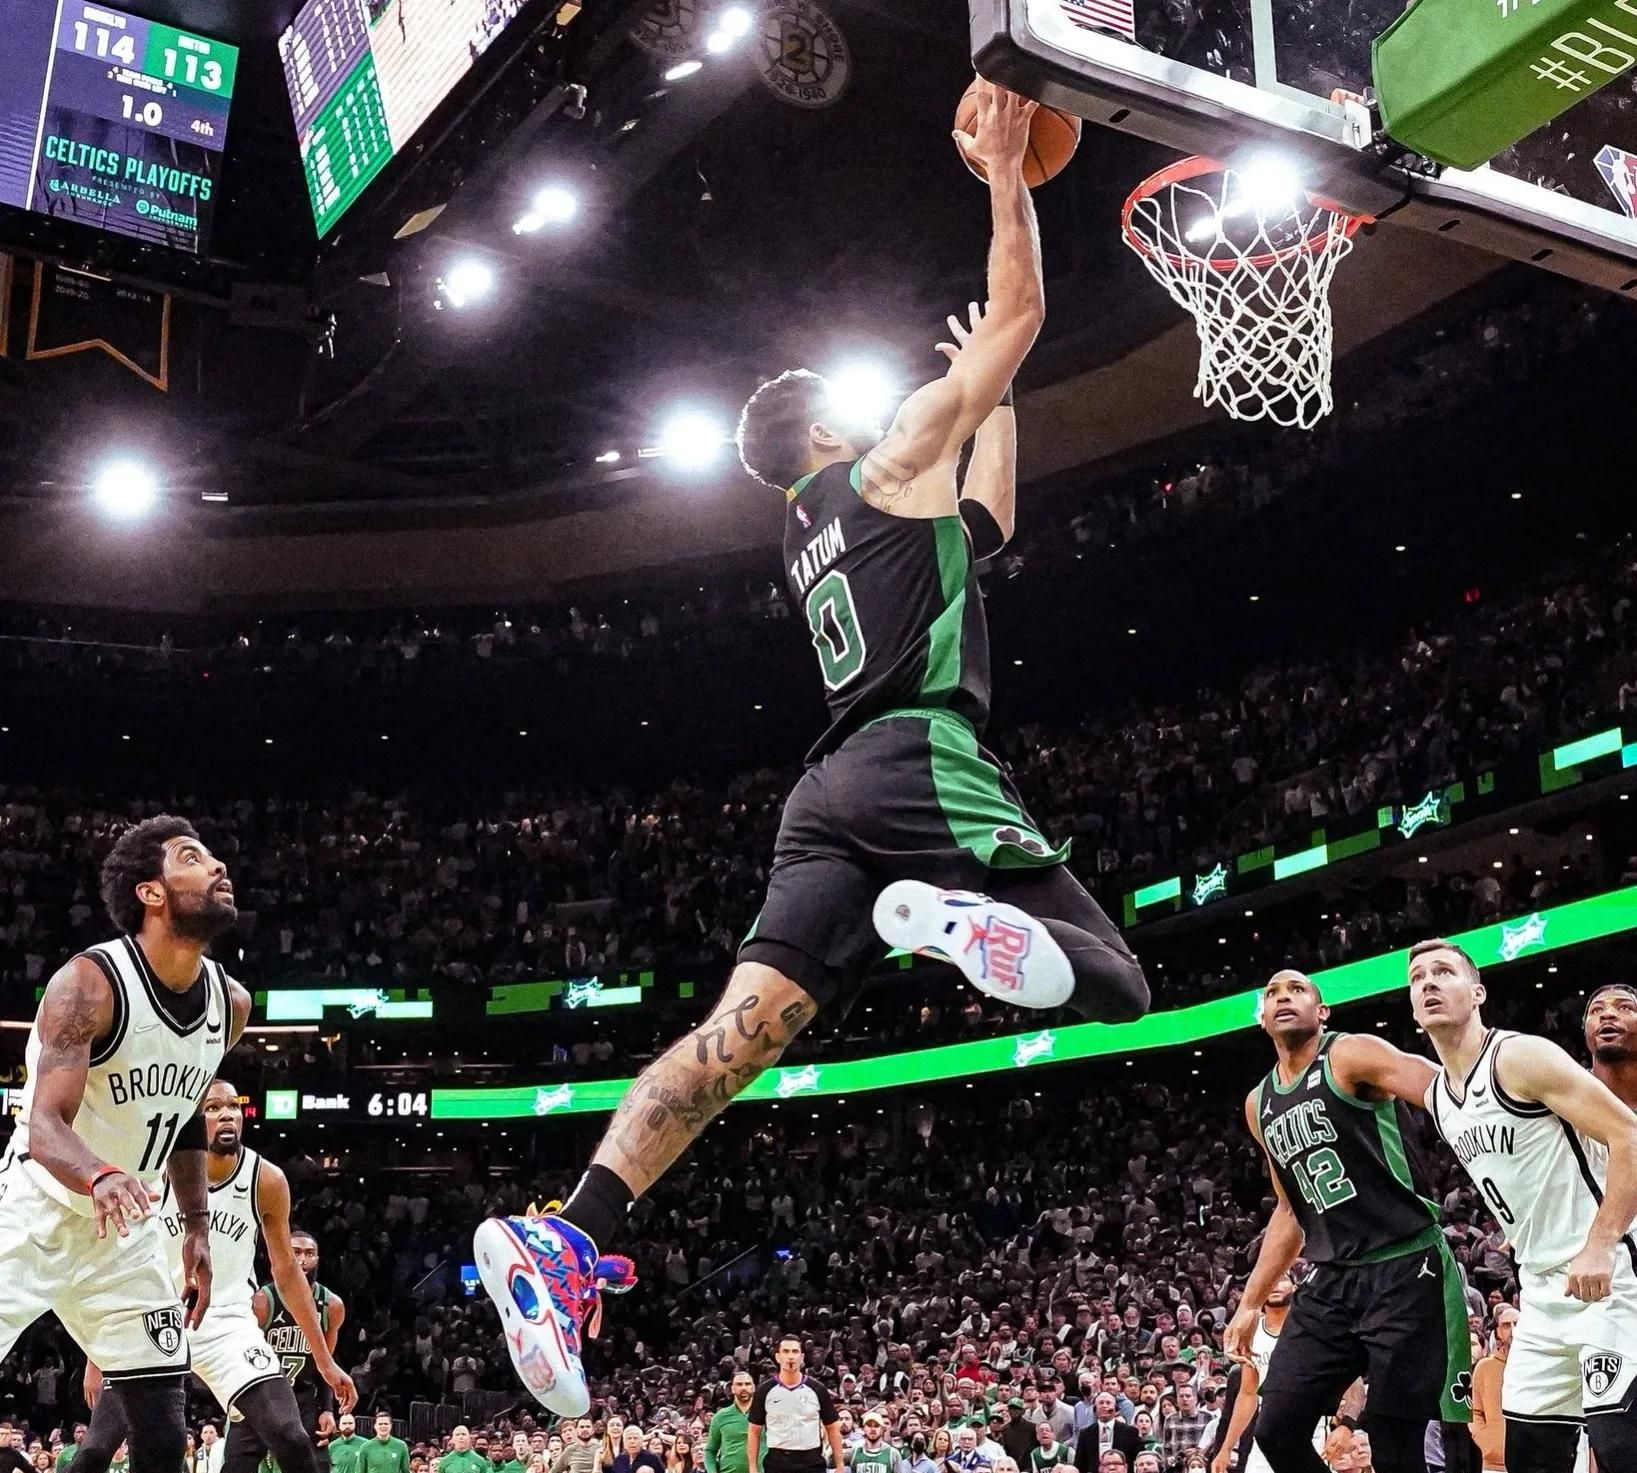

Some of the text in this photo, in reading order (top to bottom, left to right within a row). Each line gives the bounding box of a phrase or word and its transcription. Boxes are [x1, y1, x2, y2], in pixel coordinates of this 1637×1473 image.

[74, 21, 135, 64] 114
[164, 48, 222, 90] 113
[122, 94, 163, 127] 1.0
[190, 119, 214, 137] 4th
[45, 135, 212, 200] CELTICS PLAYOFFS
[60, 181, 121, 204] ARBELLA
[92, 175, 161, 199] PRESENTED BY
[150, 204, 197, 226] Putnam
[791, 516, 846, 594] TATUM
[806, 569, 866, 691] 0
[108, 1063, 212, 1105] BROOKLY
[302, 1093, 350, 1109] Bank
[367, 1092, 428, 1116] 6:04
[138, 1113, 179, 1171] 11
[1264, 1098, 1338, 1169] CELTICS
[1454, 1124, 1515, 1168] ROOKLYN
[1292, 1147, 1357, 1214] 42
[1482, 1177, 1515, 1225] 9
[164, 1209, 248, 1242] BRKLYN
[147, 1310, 182, 1332] NETS
[267, 1325, 312, 1354] CELTI
[281, 1355, 306, 1387] 7
[1584, 1356, 1618, 1377] NETS
